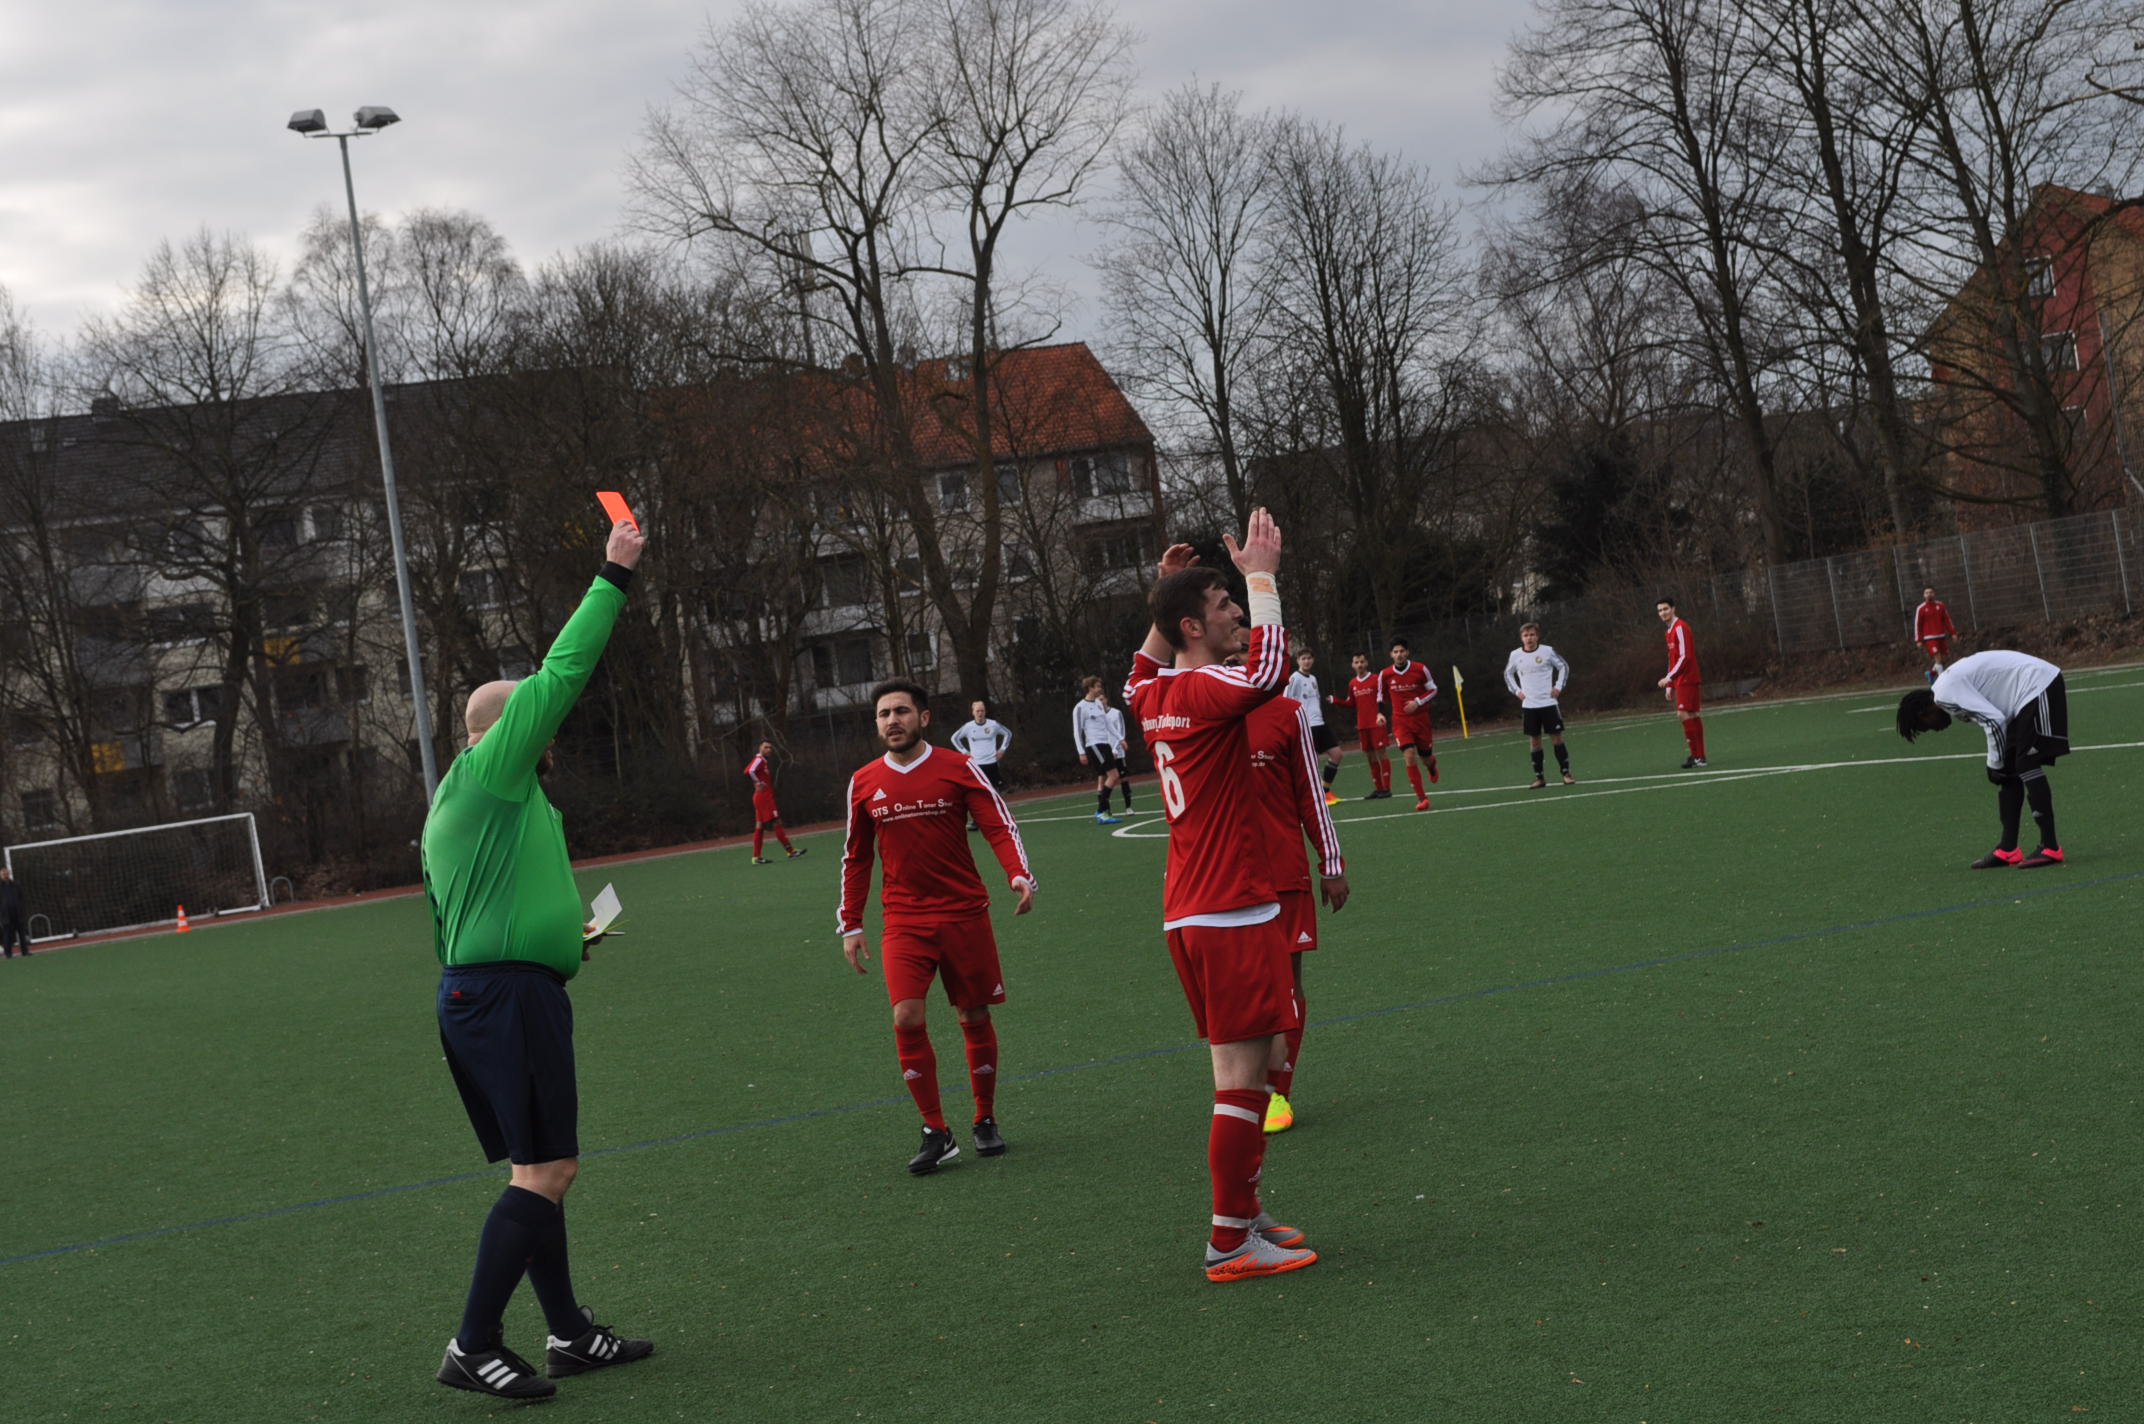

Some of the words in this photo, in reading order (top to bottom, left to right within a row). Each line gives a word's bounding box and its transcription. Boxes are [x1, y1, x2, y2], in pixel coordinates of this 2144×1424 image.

[1155, 740, 1185, 819] 6
[872, 806, 888, 818] OTS
[894, 803, 916, 812] Online
